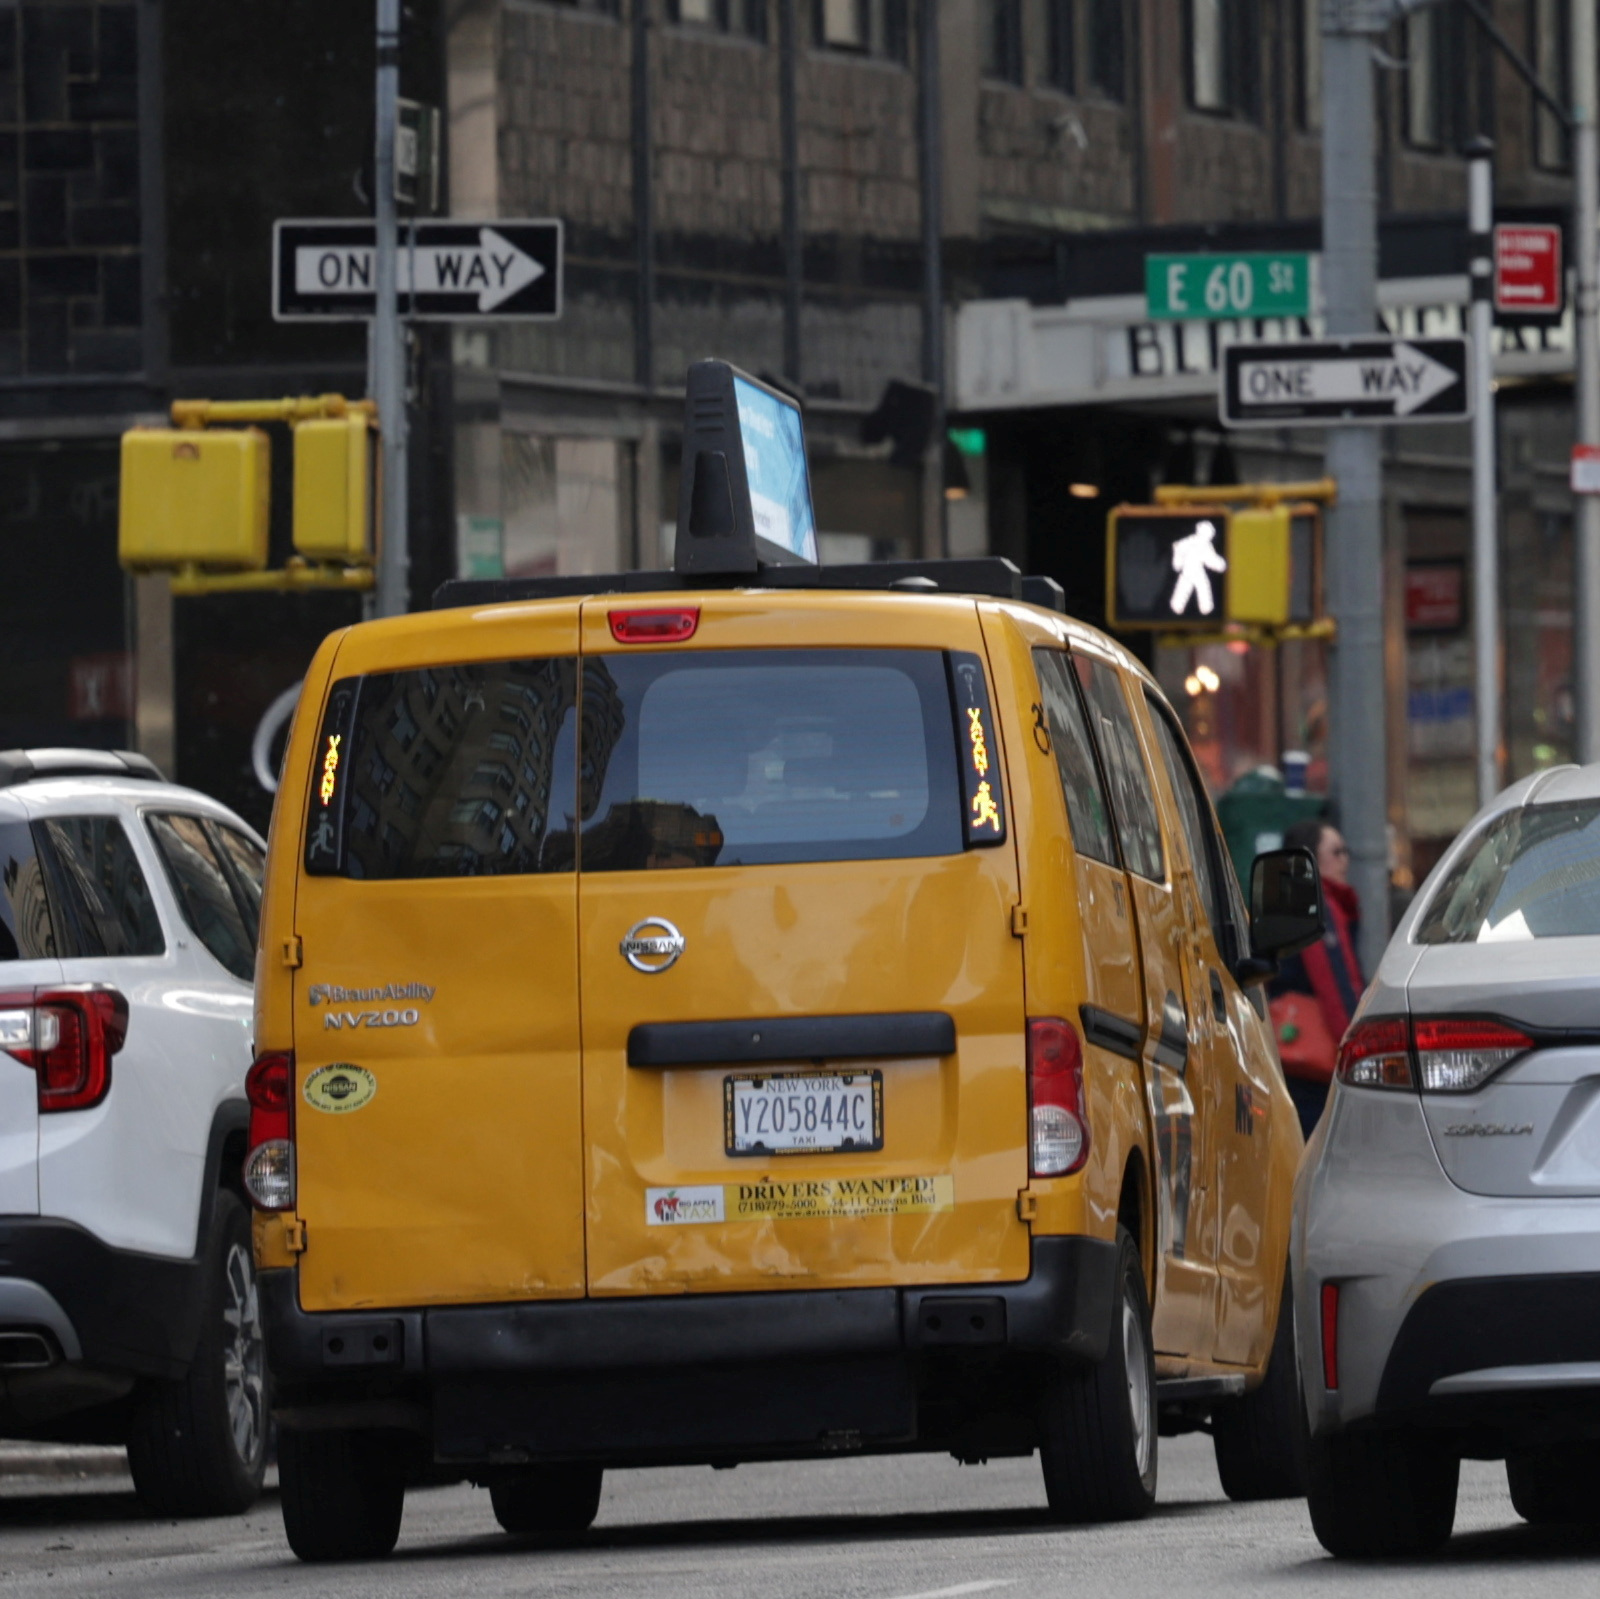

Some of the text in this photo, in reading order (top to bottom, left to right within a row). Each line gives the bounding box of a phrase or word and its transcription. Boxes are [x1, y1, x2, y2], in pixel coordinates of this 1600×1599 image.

[318, 252, 515, 288] ON WAY
[1167, 262, 1295, 311] E 60 St
[1248, 364, 1429, 399] ONE WAY
[967, 707, 990, 778] VACANT
[624, 941, 679, 954] NISSAN
[332, 981, 437, 1003] BraunAbility
[324, 1008, 420, 1030] NV200
[322, 1082, 358, 1093] NISSAN
[765, 1077, 841, 1094] NEW YORK
[739, 1093, 866, 1135] Y205844C
[791, 1135, 817, 1146] TAXI
[739, 1177, 935, 1201] DRIVERS WANTED!
[866, 1194, 908, 1207] Queens
[911, 1192, 936, 1205] Blvd
[681, 1206, 717, 1220] TAXI
[692, 1199, 717, 1207] APPLE
